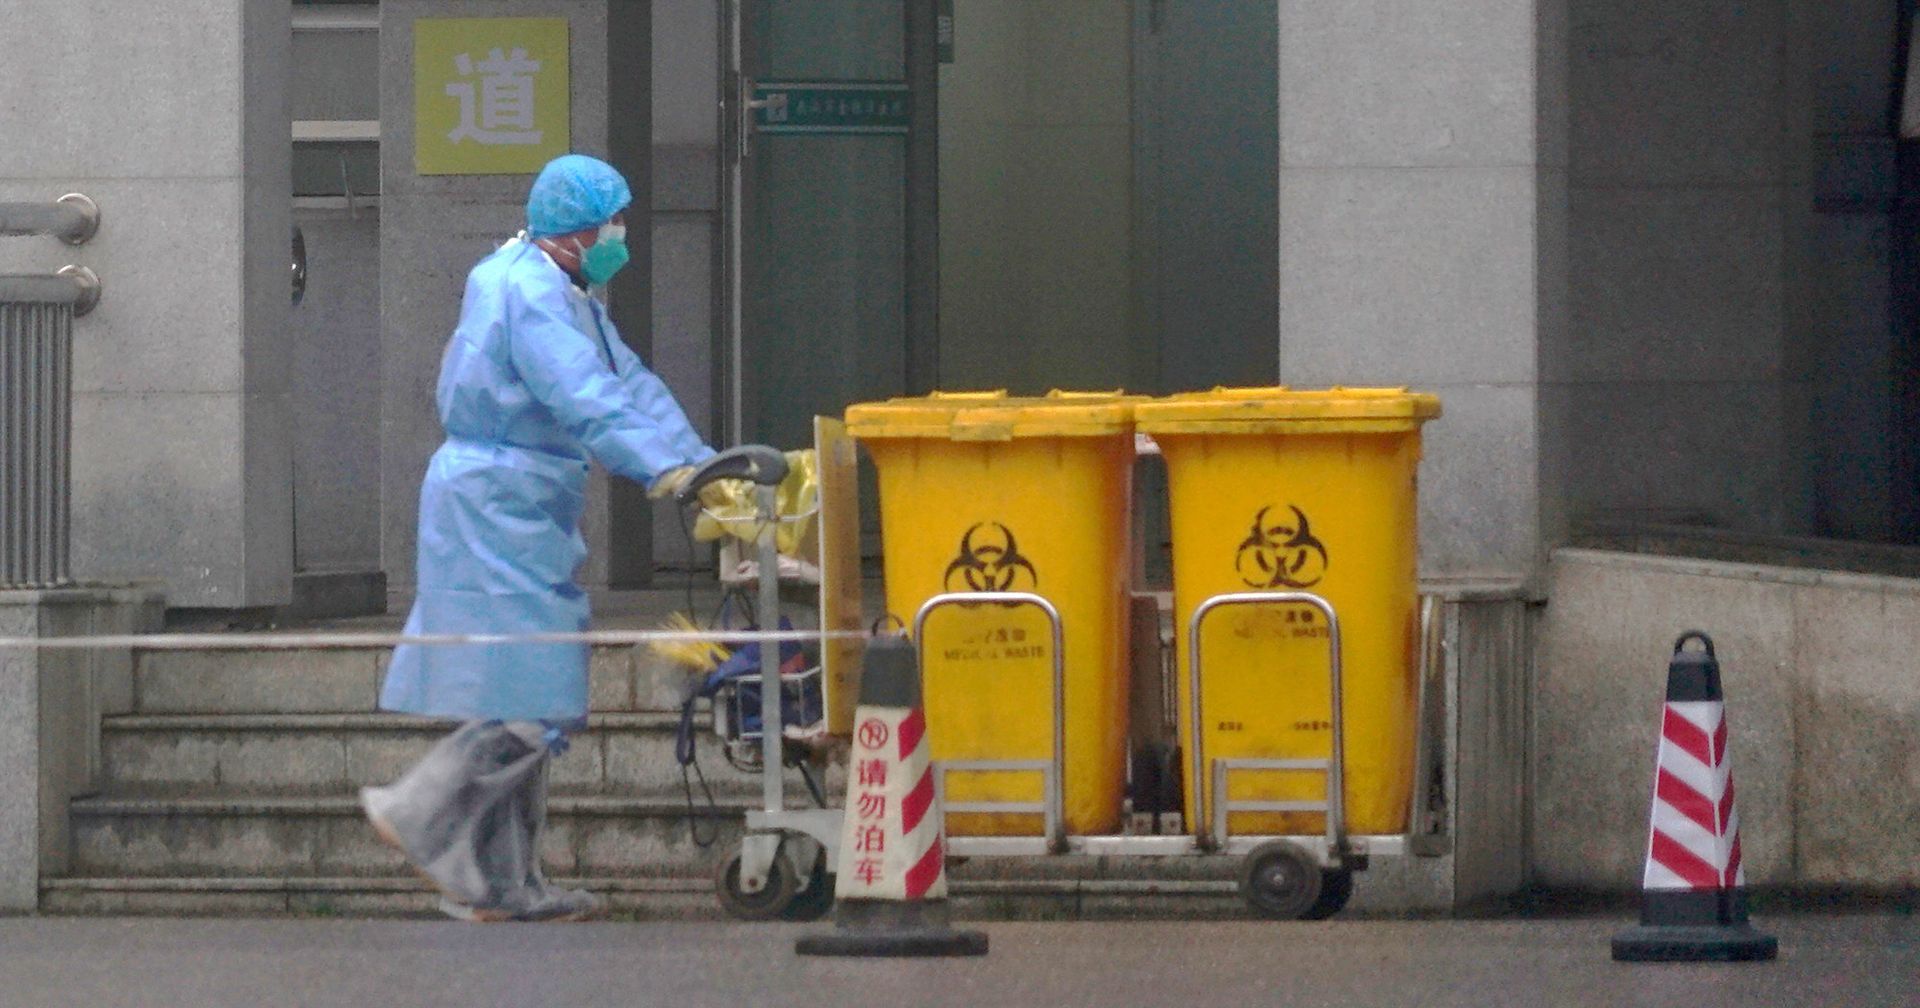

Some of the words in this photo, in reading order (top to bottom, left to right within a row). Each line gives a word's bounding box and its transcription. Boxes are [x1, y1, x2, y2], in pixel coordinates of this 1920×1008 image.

[446, 47, 544, 145] 道
[855, 758, 887, 886] 请勿泊车
